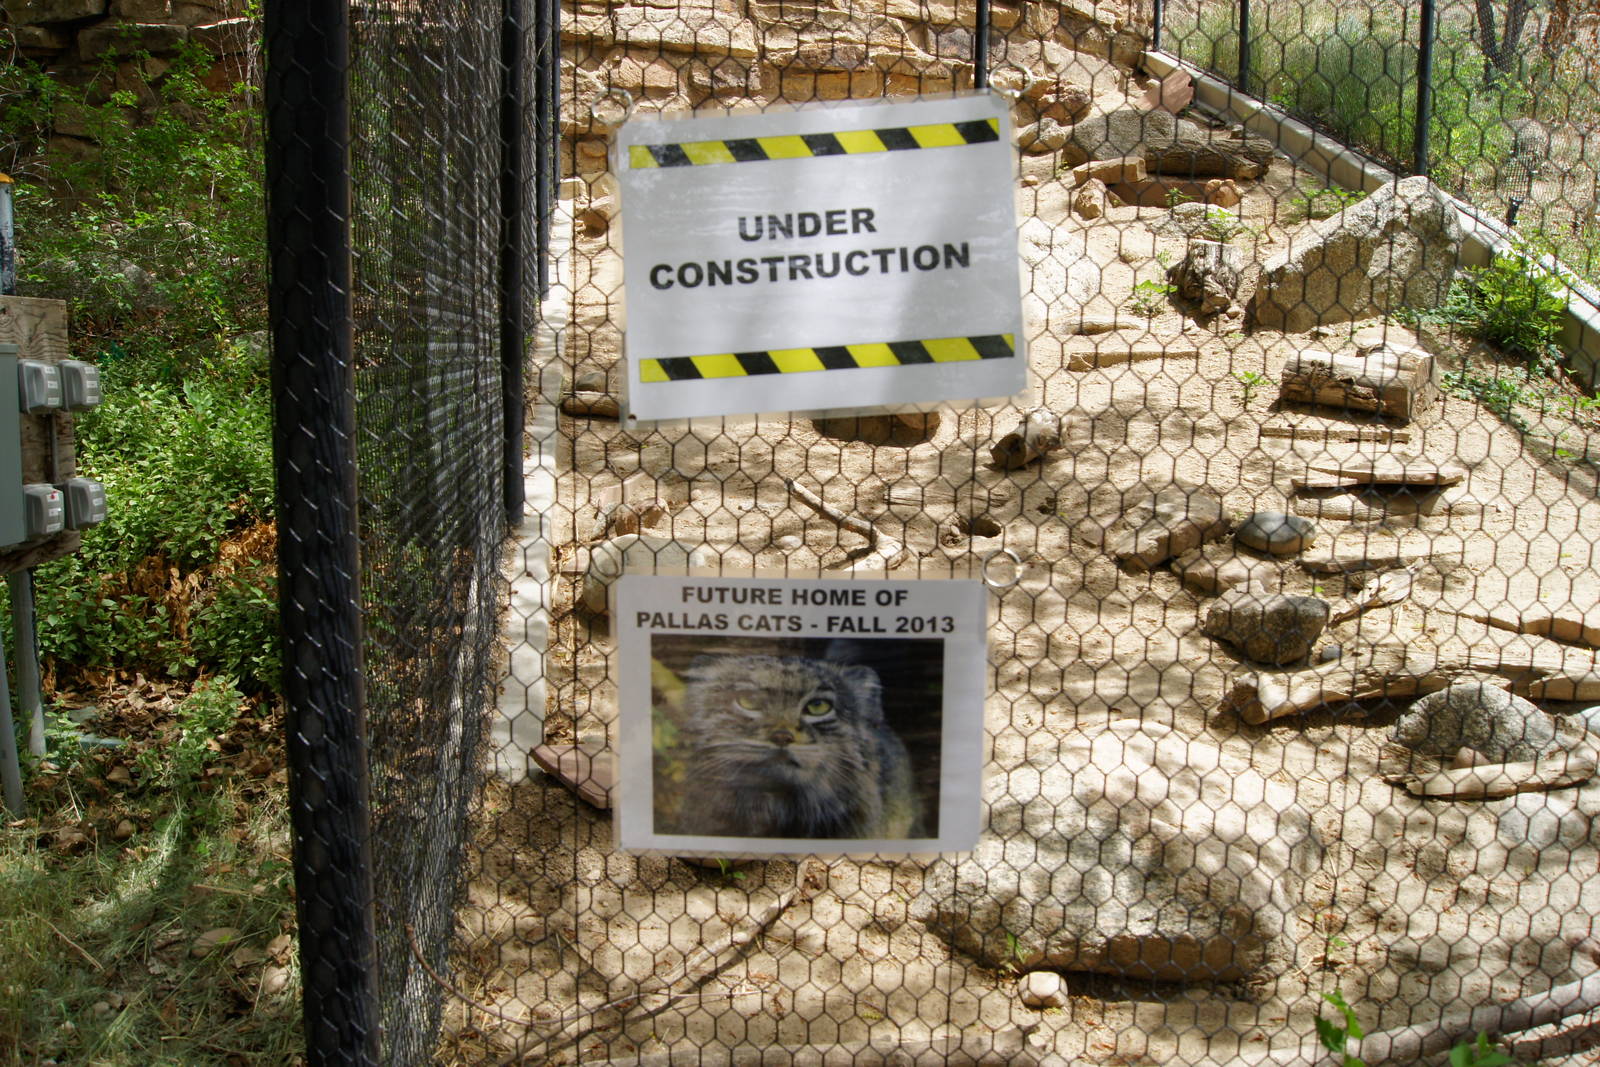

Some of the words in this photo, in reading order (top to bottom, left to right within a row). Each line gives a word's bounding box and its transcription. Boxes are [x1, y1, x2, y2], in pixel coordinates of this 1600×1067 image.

[738, 208, 877, 242] UNDER
[650, 242, 970, 290] CONSTRUCTION
[681, 586, 782, 605] FUTURE
[791, 588, 866, 606] HOME
[875, 589, 909, 607] OF
[636, 612, 729, 630] PALLAS
[737, 614, 803, 632] CATS
[826, 616, 887, 633] FALL
[895, 616, 954, 634] 2013
